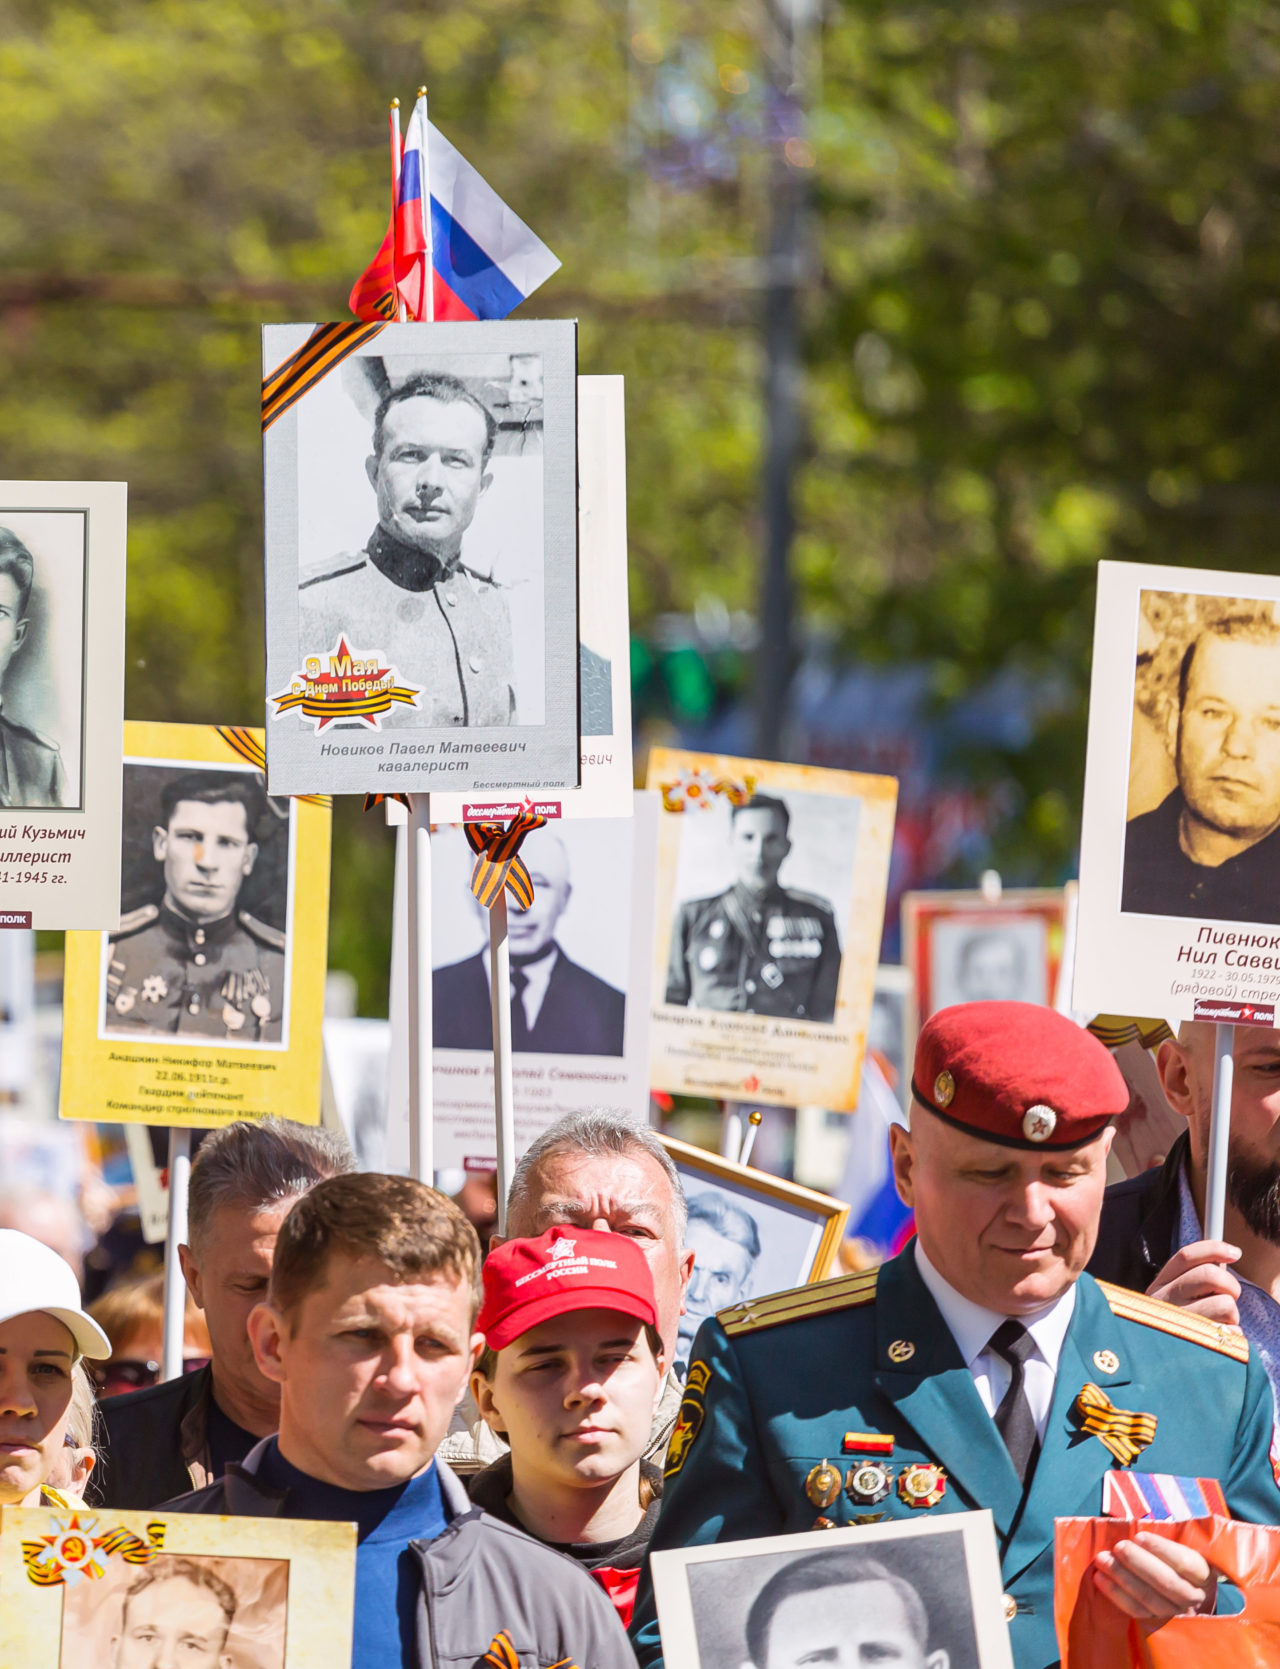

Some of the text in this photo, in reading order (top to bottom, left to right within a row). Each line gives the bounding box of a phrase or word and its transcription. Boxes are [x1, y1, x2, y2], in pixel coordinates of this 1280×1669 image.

[306, 655, 379, 679] 9 Мая
[305, 681, 338, 697] Днем
[342, 675, 395, 692] Победы!
[320, 741, 528, 756] Новиков Павел Матвеевич
[378, 760, 469, 774] кавалерист
[581, 754, 613, 765] евич
[473, 779, 566, 790] Бессмертный полк
[22, 825, 86, 842] Кузьмич
[51, 875, 68, 884] гг.
[1197, 927, 1280, 949] Пивнюк
[1177, 946, 1217, 964] Нил
[1192, 969, 1216, 979] 1922
[1170, 980, 1237, 999] (рядовой)
